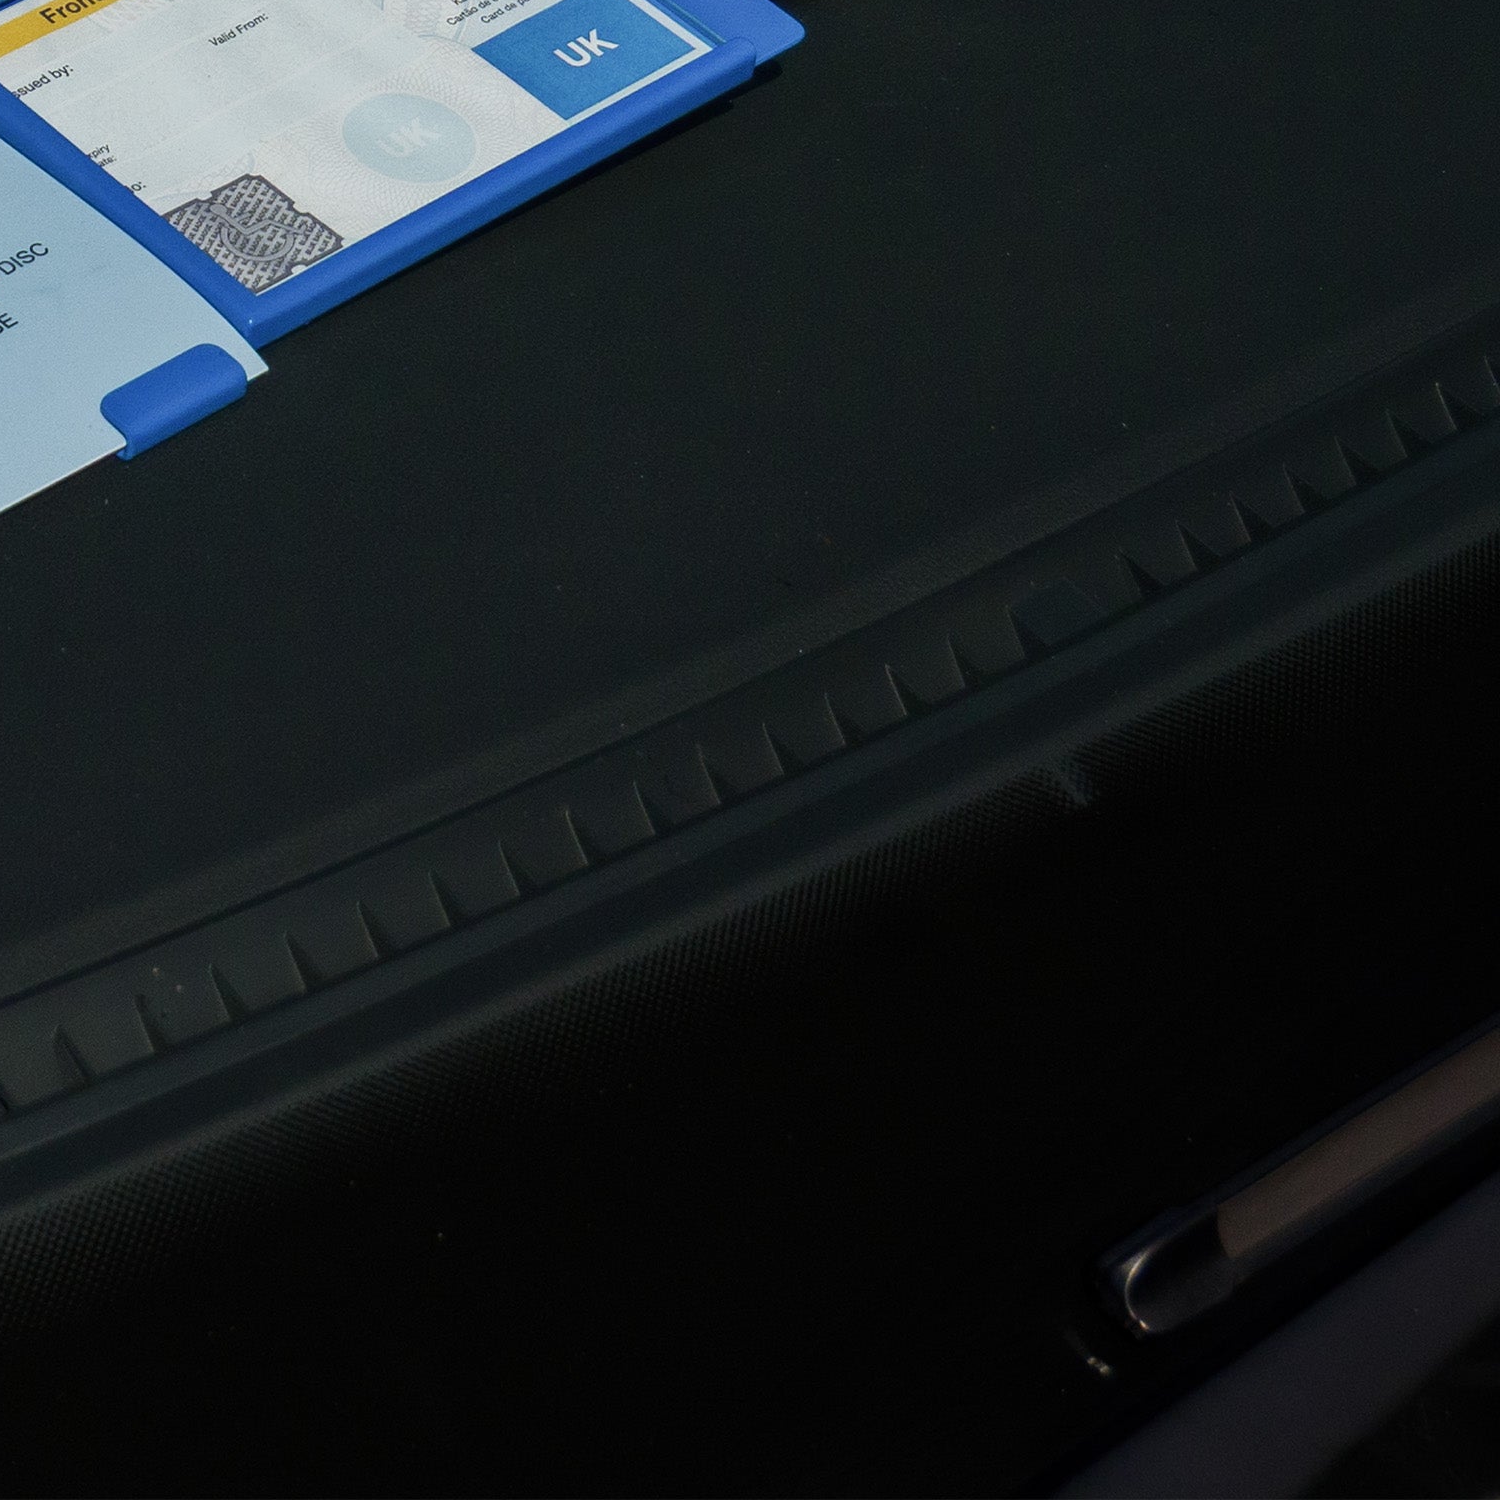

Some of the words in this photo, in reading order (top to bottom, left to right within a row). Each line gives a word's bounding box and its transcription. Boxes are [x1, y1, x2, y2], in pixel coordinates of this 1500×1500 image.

[478, 0, 491, 10] de
[480, 8, 505, 24] Card
[504, 1, 517, 12] de
[208, 29, 237, 47] Valid
[235, 11, 269, 34] From:
[552, 28, 620, 68] UK
[11, 74, 51, 99] ssued
[48, 64, 74, 79] by:
